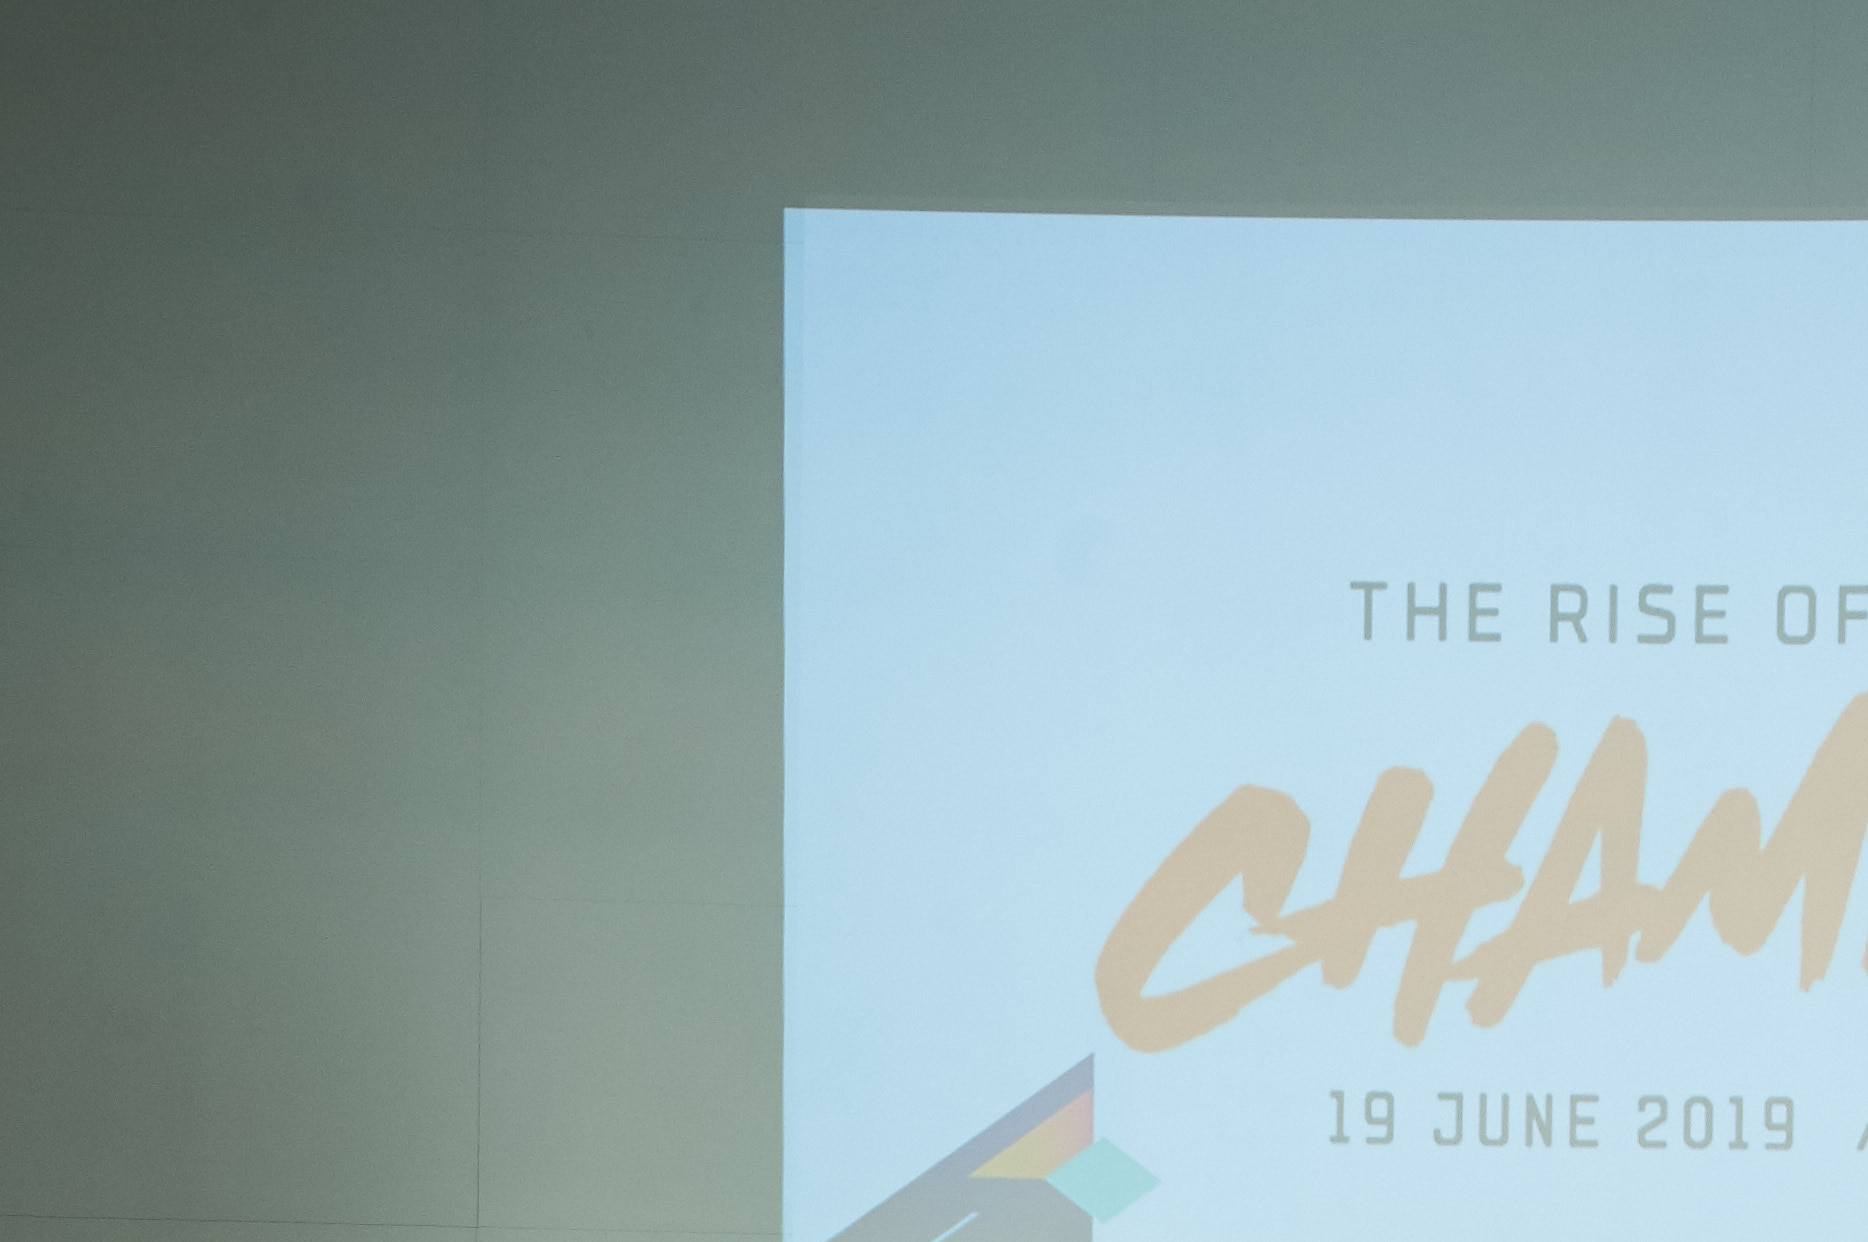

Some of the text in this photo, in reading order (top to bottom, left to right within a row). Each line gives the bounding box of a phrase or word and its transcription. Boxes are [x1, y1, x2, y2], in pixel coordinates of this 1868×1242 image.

[1350, 580, 1502, 642] THE
[1549, 583, 1730, 643] RISE
[1330, 1090, 1394, 1144] 19
[1433, 1092, 1599, 1147] JUNE
[1638, 1095, 1795, 1150] 2019
